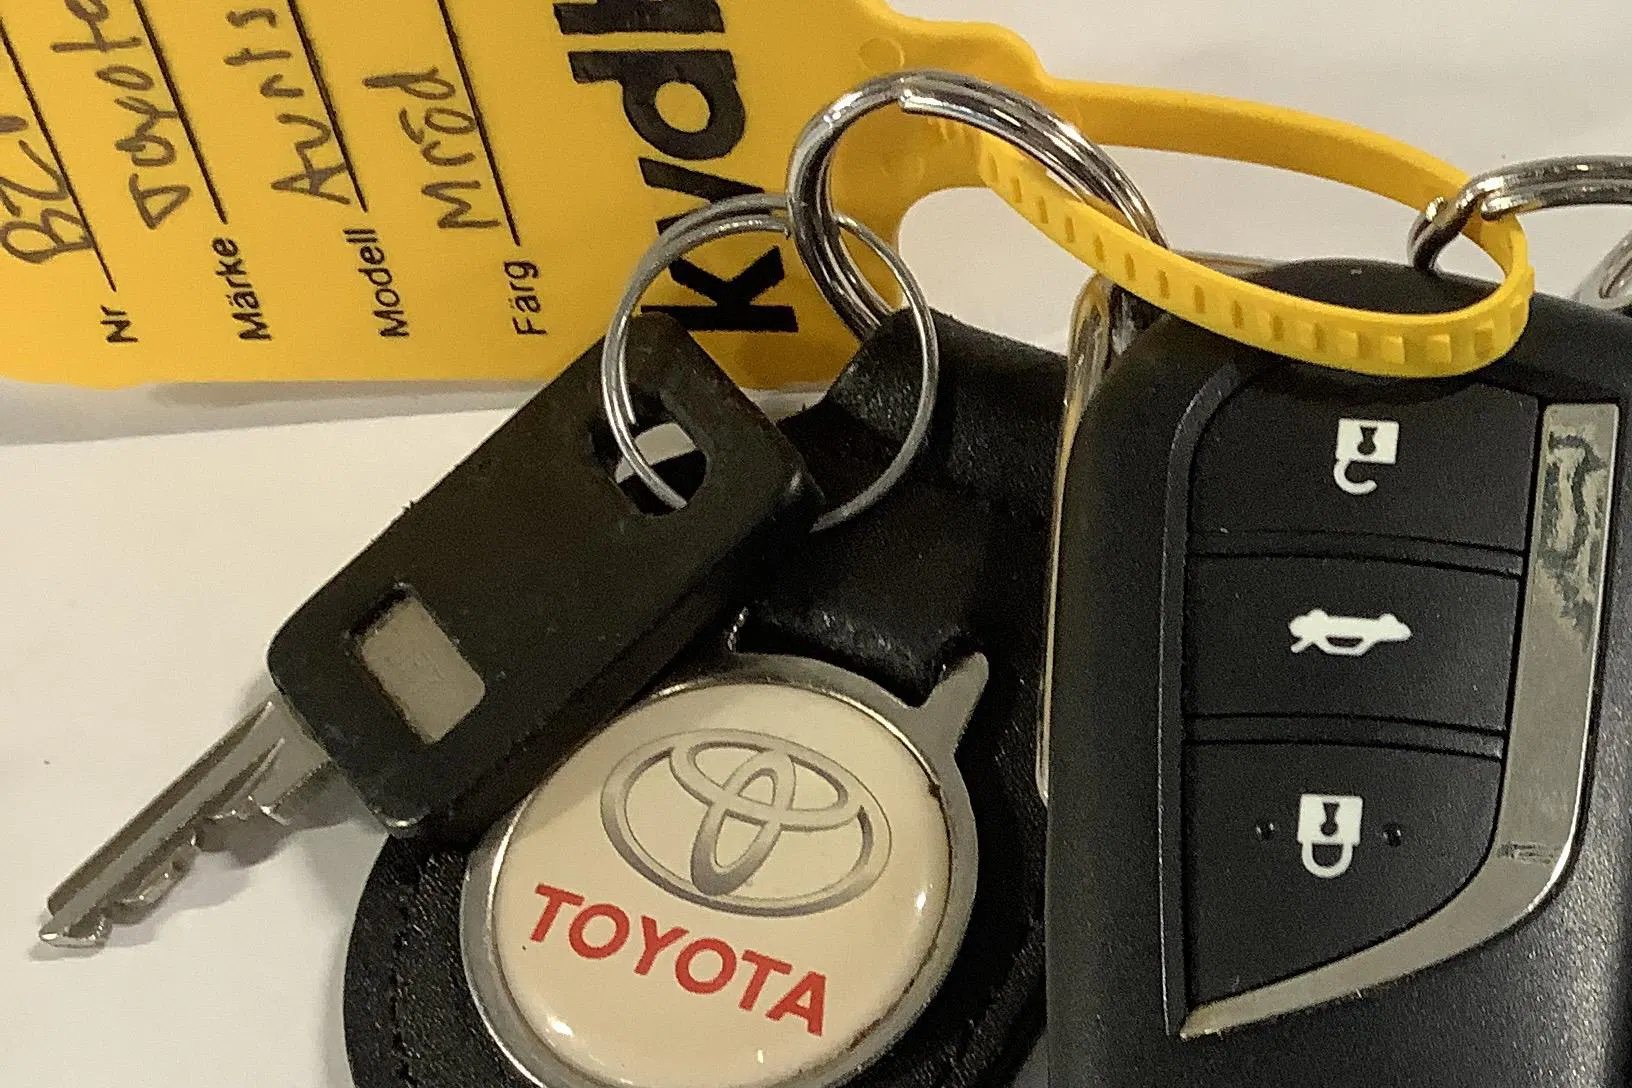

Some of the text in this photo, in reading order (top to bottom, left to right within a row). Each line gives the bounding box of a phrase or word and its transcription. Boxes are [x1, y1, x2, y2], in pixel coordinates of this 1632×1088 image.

[99, 303, 139, 343] Nr
[211, 236, 273, 341] Märke
[342, 227, 411, 339] Modell
[502, 259, 548, 338] Färg
[528, 882, 828, 1038] TOYOTA
